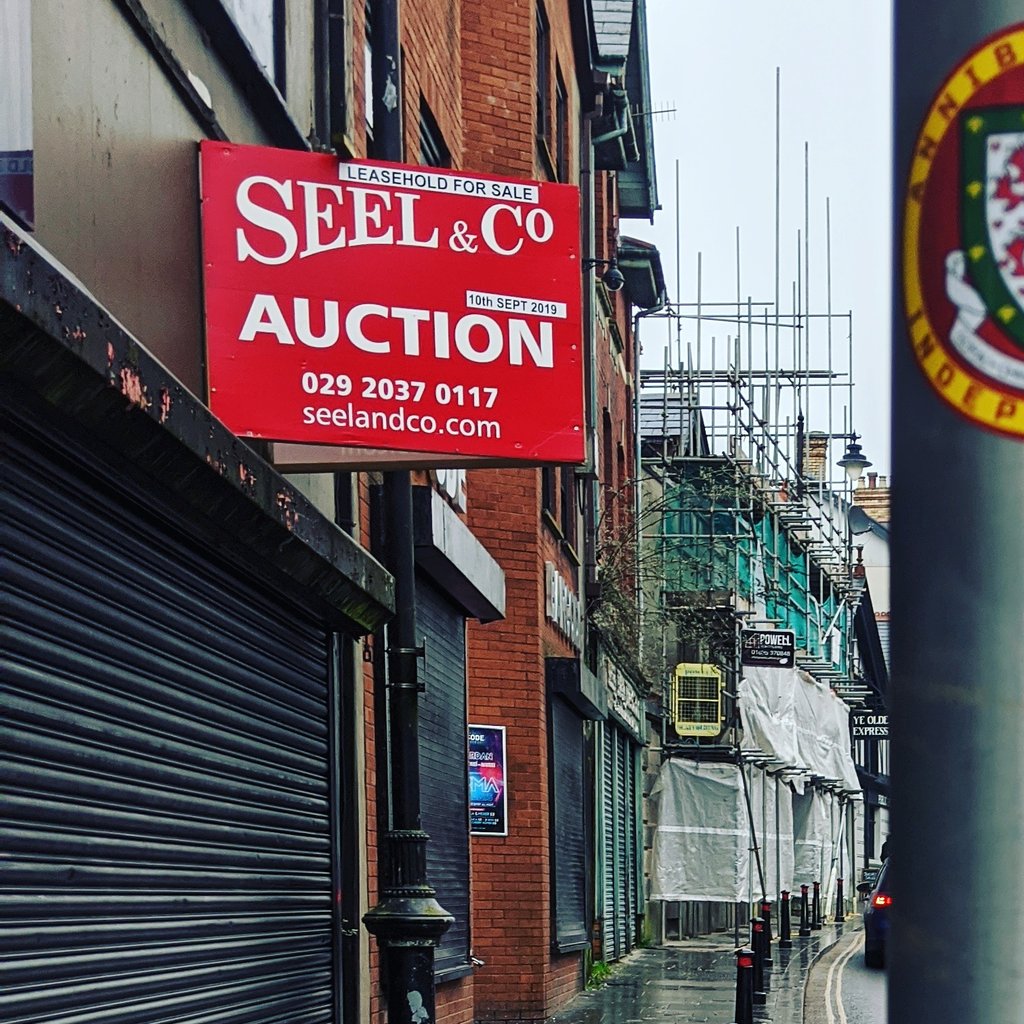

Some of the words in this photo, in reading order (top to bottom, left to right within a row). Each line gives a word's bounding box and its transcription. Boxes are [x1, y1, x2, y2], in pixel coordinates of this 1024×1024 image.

[347, 166, 448, 191] LEASEHOLD
[453, 178, 486, 195] FOR
[491, 183, 533, 201] SALE
[236, 175, 439, 265] SEEL
[448, 220, 479, 254] &
[468, 294, 494, 309] 10th
[496, 297, 528, 313] SEPT
[531, 301, 558, 316] 2019
[238, 293, 554, 368] AUCTION
[301, 371, 353, 397] 029
[361, 376, 426, 402] 2037
[435, 382, 498, 409] 0117
[302, 402, 502, 440] seelandco.com
[760, 633, 792, 646] POWELL
[853, 715, 867, 725] YE
[867, 715, 889, 725] OLDE
[853, 726, 889, 736] EXPRESS
